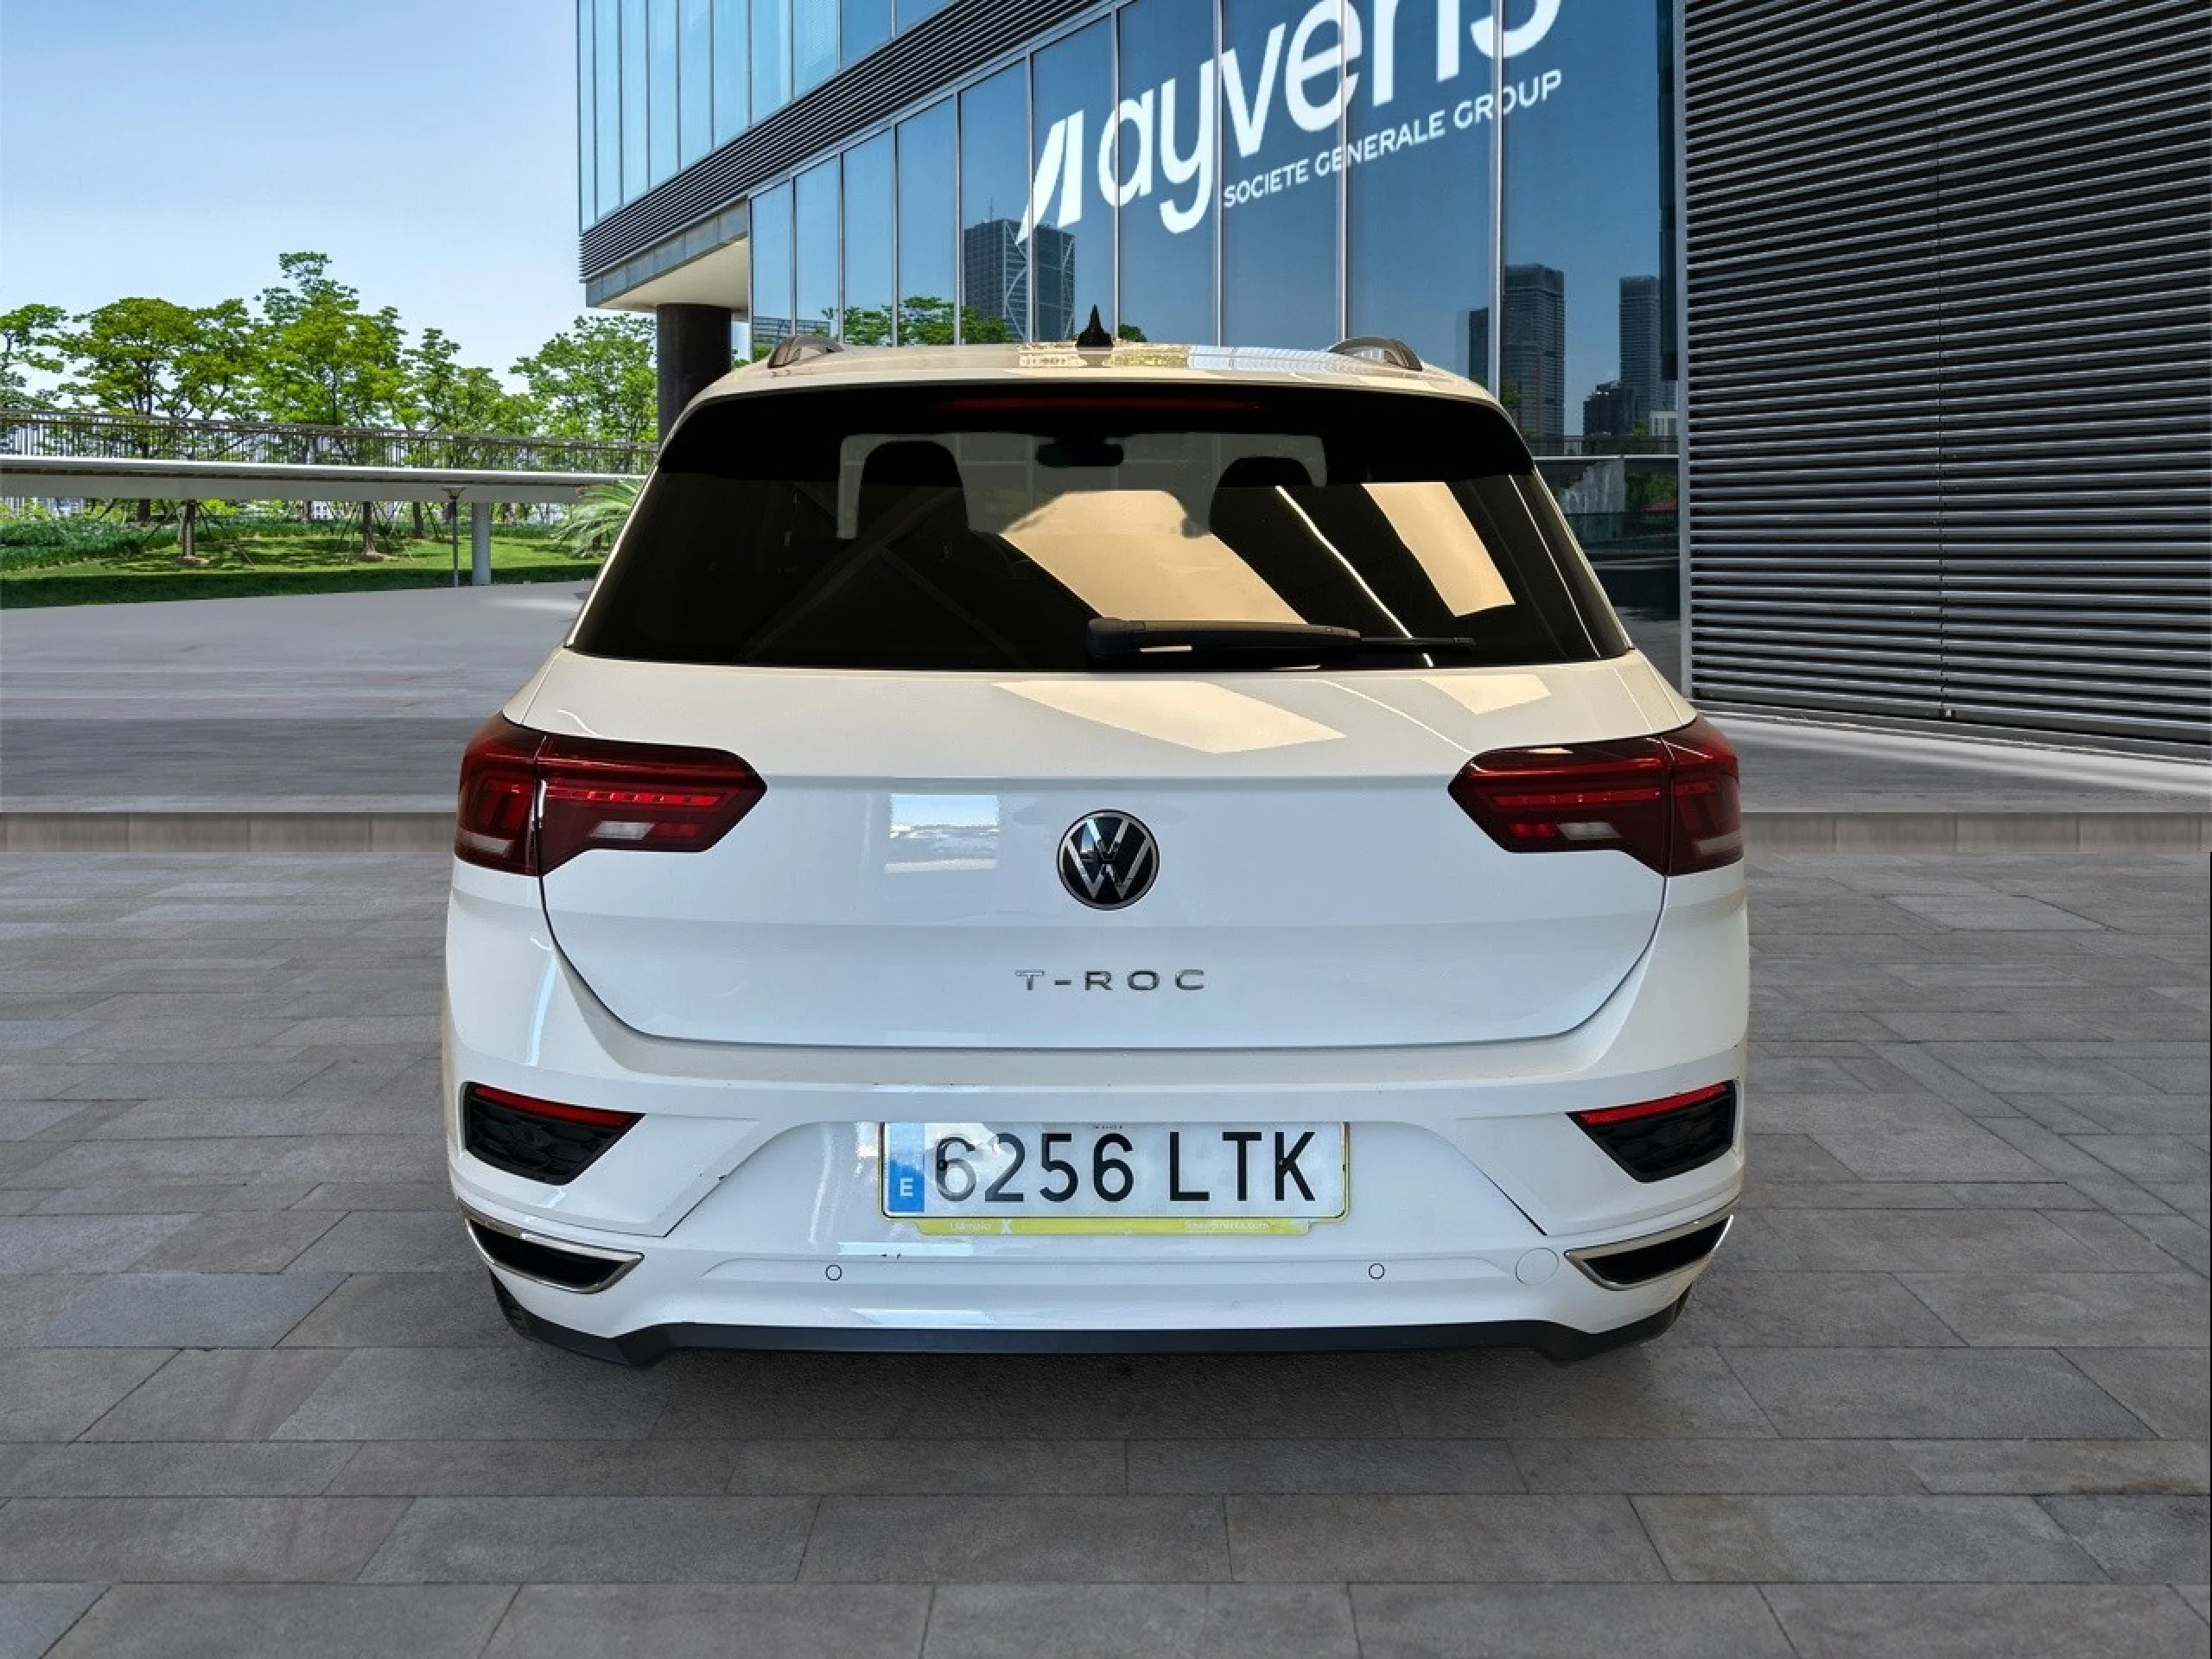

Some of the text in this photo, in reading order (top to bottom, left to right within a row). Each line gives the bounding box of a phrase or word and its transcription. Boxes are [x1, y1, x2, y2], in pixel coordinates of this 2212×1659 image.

[1224, 68, 1562, 208] SOCIETE GENERALE GROUP
[1014, 969, 1205, 991] T-ROC
[899, 1178, 913, 1197] E
[935, 1131, 1316, 1202] 6256 LTK
